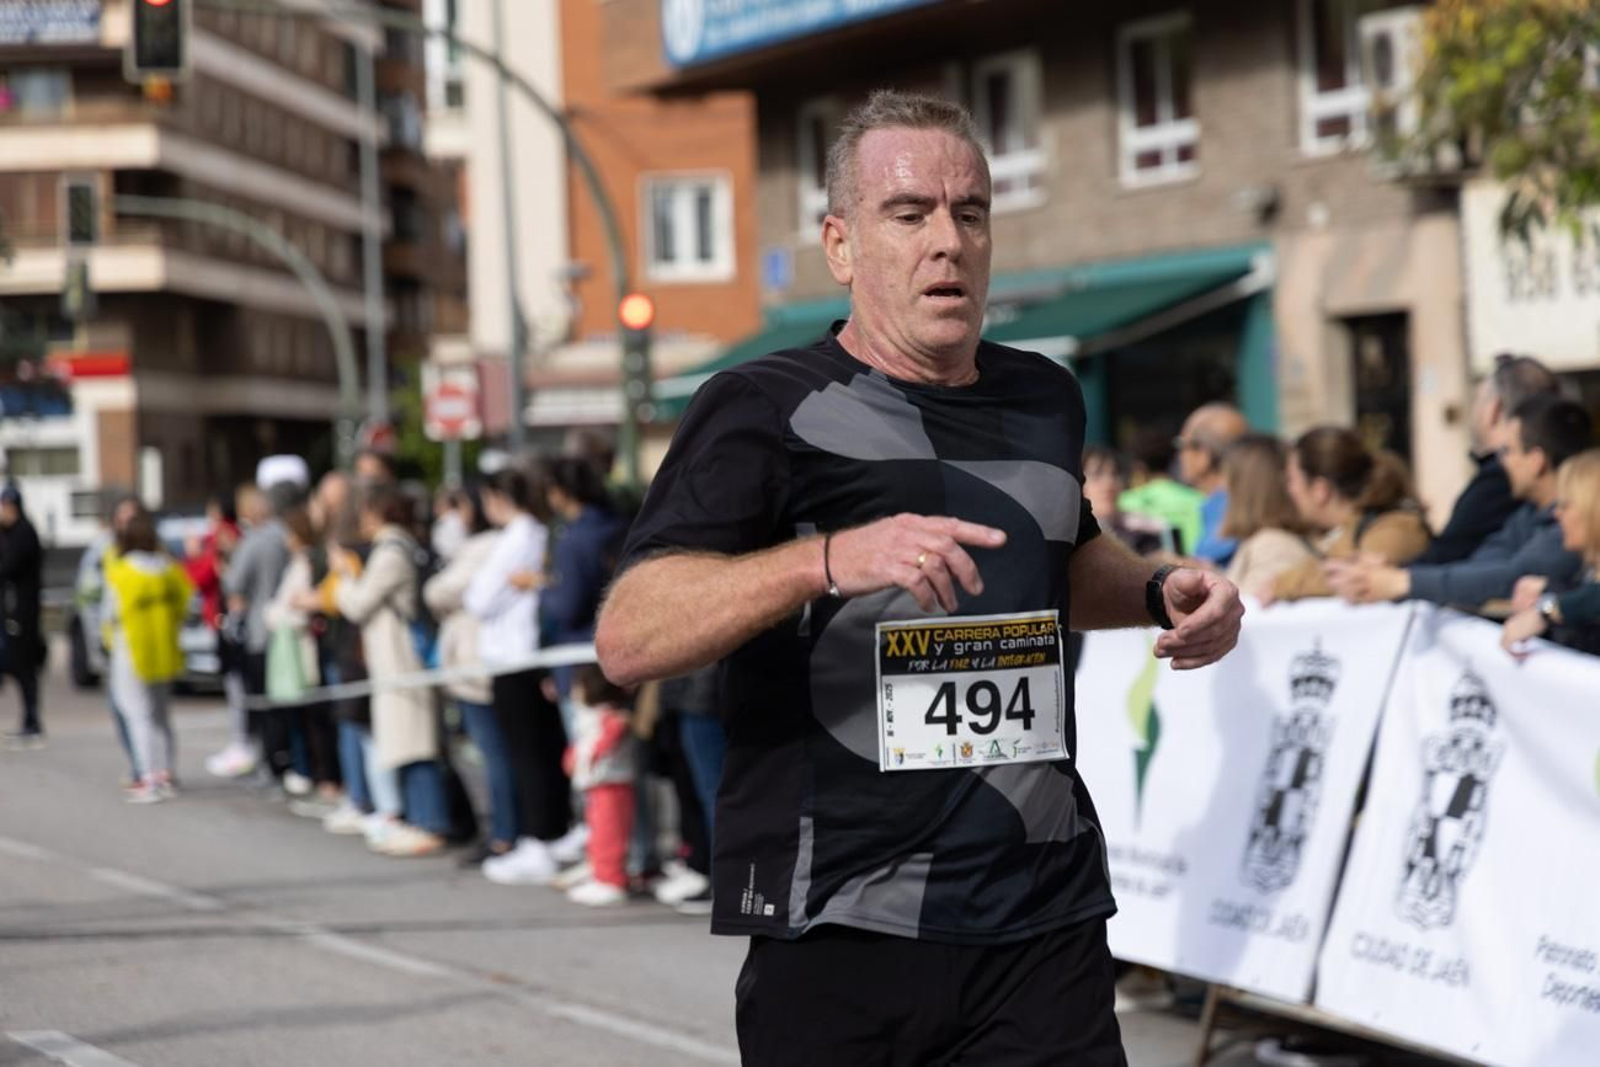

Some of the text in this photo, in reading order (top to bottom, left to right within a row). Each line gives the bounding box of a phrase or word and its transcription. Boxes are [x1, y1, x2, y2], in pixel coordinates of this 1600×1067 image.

[886, 630, 931, 657] XXV
[933, 622, 1056, 642] CARRERA POPULAR
[934, 634, 1056, 656] y gran caminata
[925, 676, 1036, 736] 494
